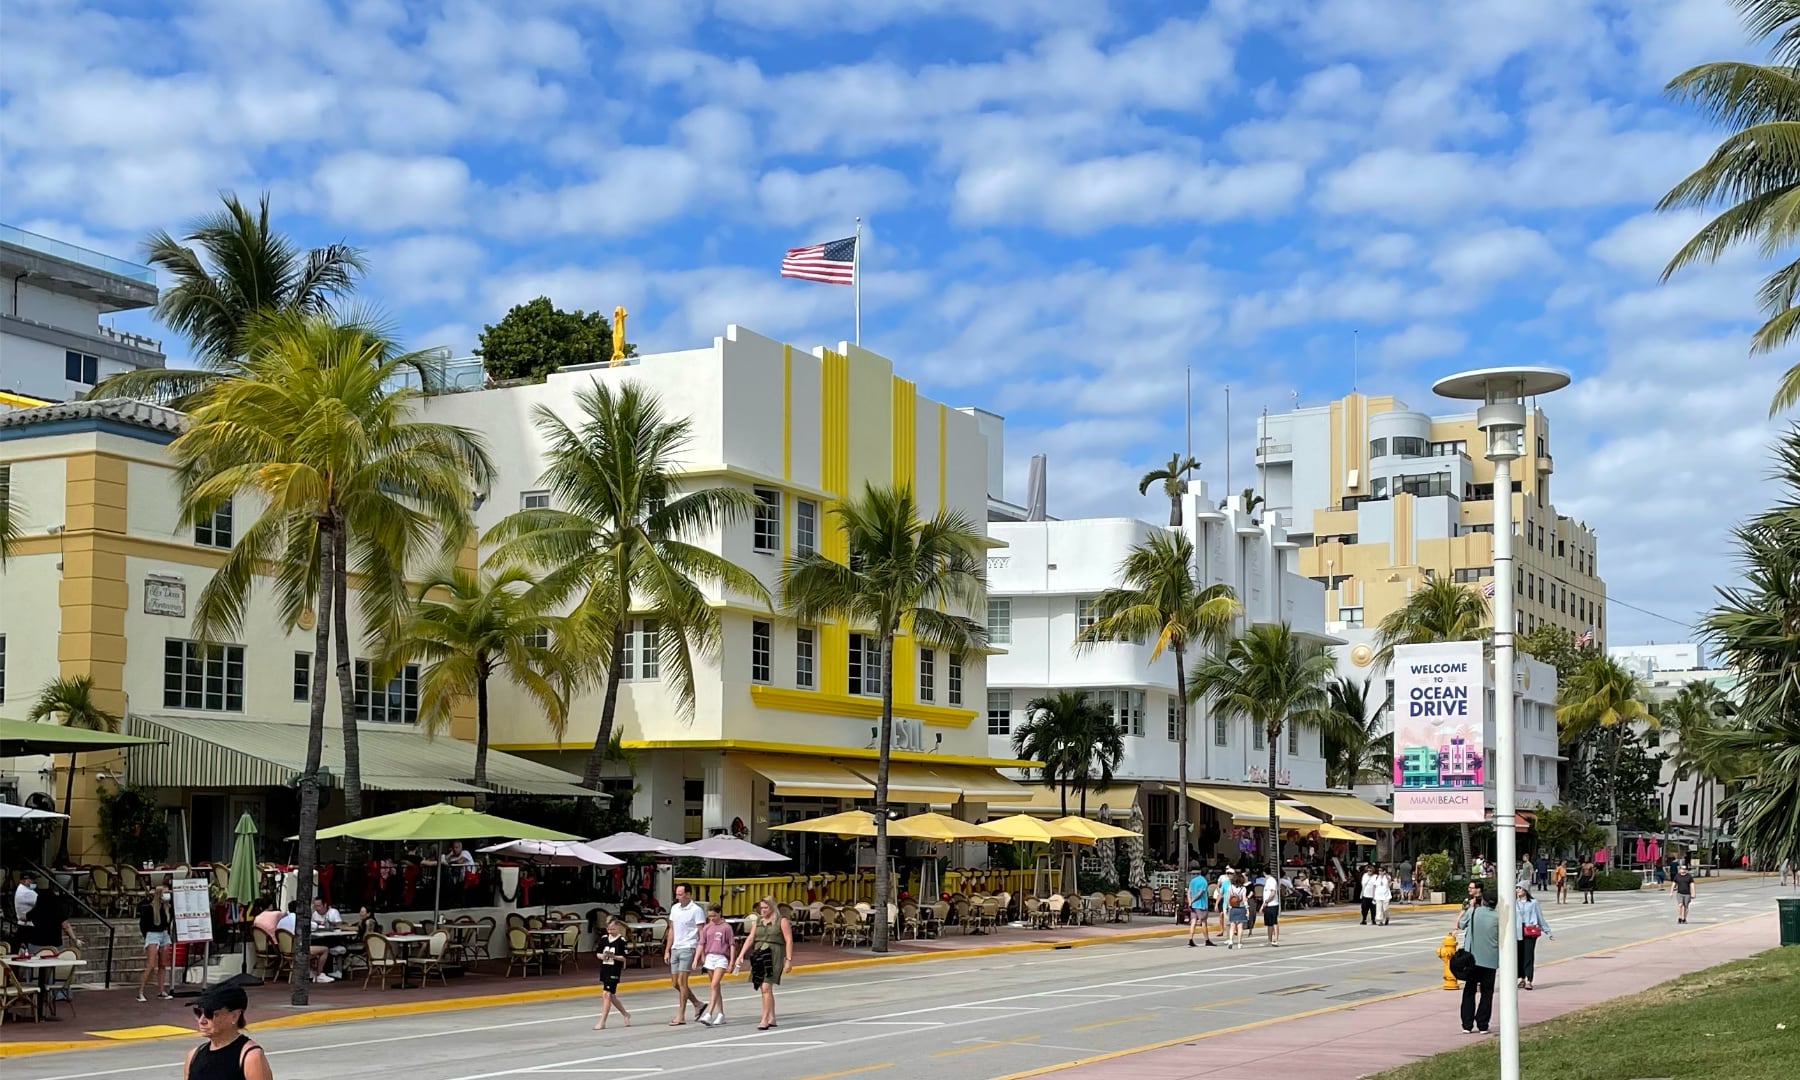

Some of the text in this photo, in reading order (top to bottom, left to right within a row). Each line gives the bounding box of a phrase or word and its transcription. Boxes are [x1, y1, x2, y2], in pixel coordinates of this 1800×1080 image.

[1410, 663, 1468, 675] WELCOME
[1410, 686, 1468, 701] OCEAN
[1410, 700, 1468, 717] DRIVE
